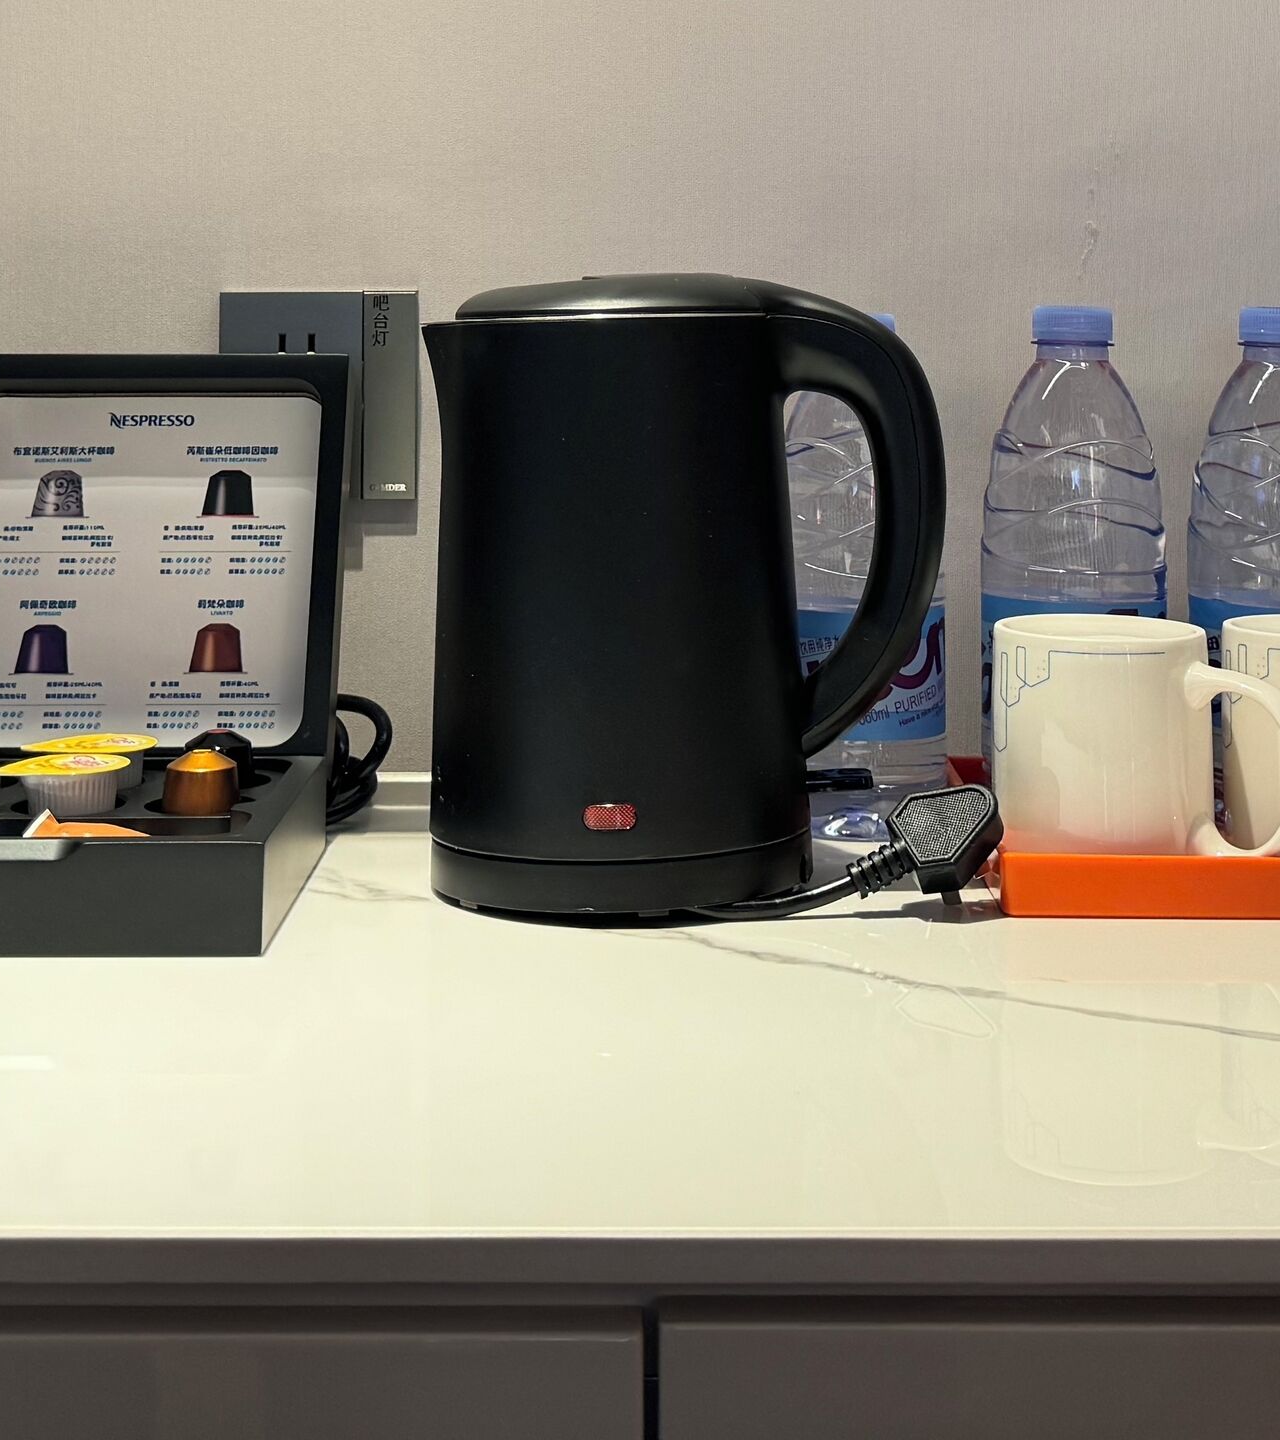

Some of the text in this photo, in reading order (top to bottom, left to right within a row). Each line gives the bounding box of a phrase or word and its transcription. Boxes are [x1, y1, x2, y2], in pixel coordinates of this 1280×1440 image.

[372, 294, 389, 347] 吧台灯
[108, 412, 195, 429] NESPRESSO
[13, 446, 115, 456] 布宜诺斯艾利斯大杯咖啡
[894, 685, 937, 714] PURIFIED
